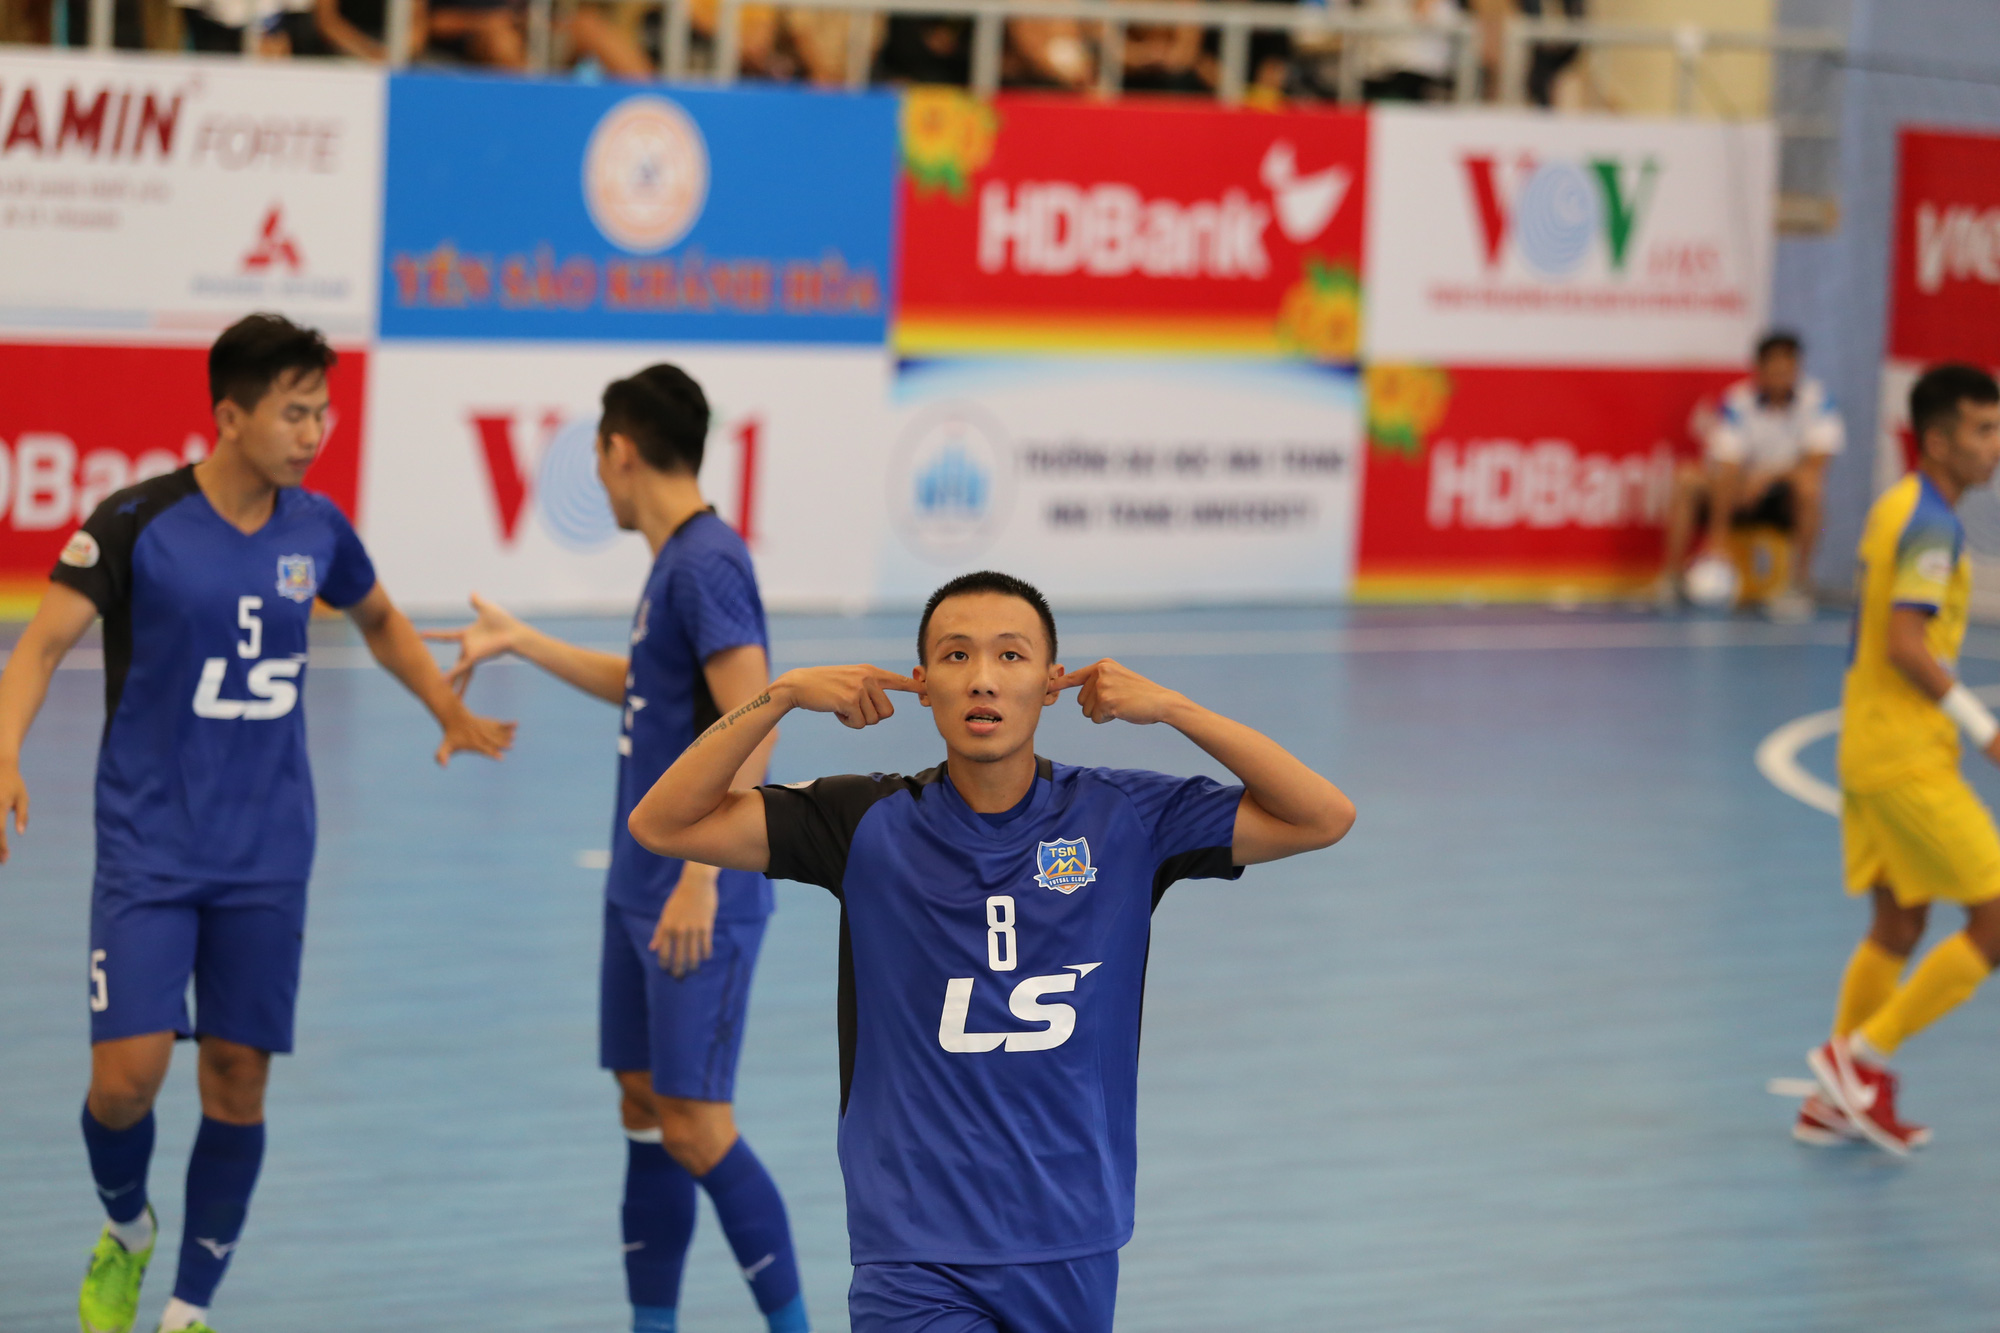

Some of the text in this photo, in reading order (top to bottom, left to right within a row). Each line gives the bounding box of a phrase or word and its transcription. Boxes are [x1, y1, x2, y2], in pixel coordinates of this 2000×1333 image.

[0, 82, 184, 160] AMIN
[978, 180, 1270, 280] HDBank
[237, 596, 263, 659] 5
[192, 657, 303, 720] LS
[1049, 846, 1077, 858] TSN
[1049, 876, 1070, 886] FUTSAL
[986, 895, 1017, 972] 8
[90, 948, 109, 1012] 5
[938, 973, 1078, 1053] LS
